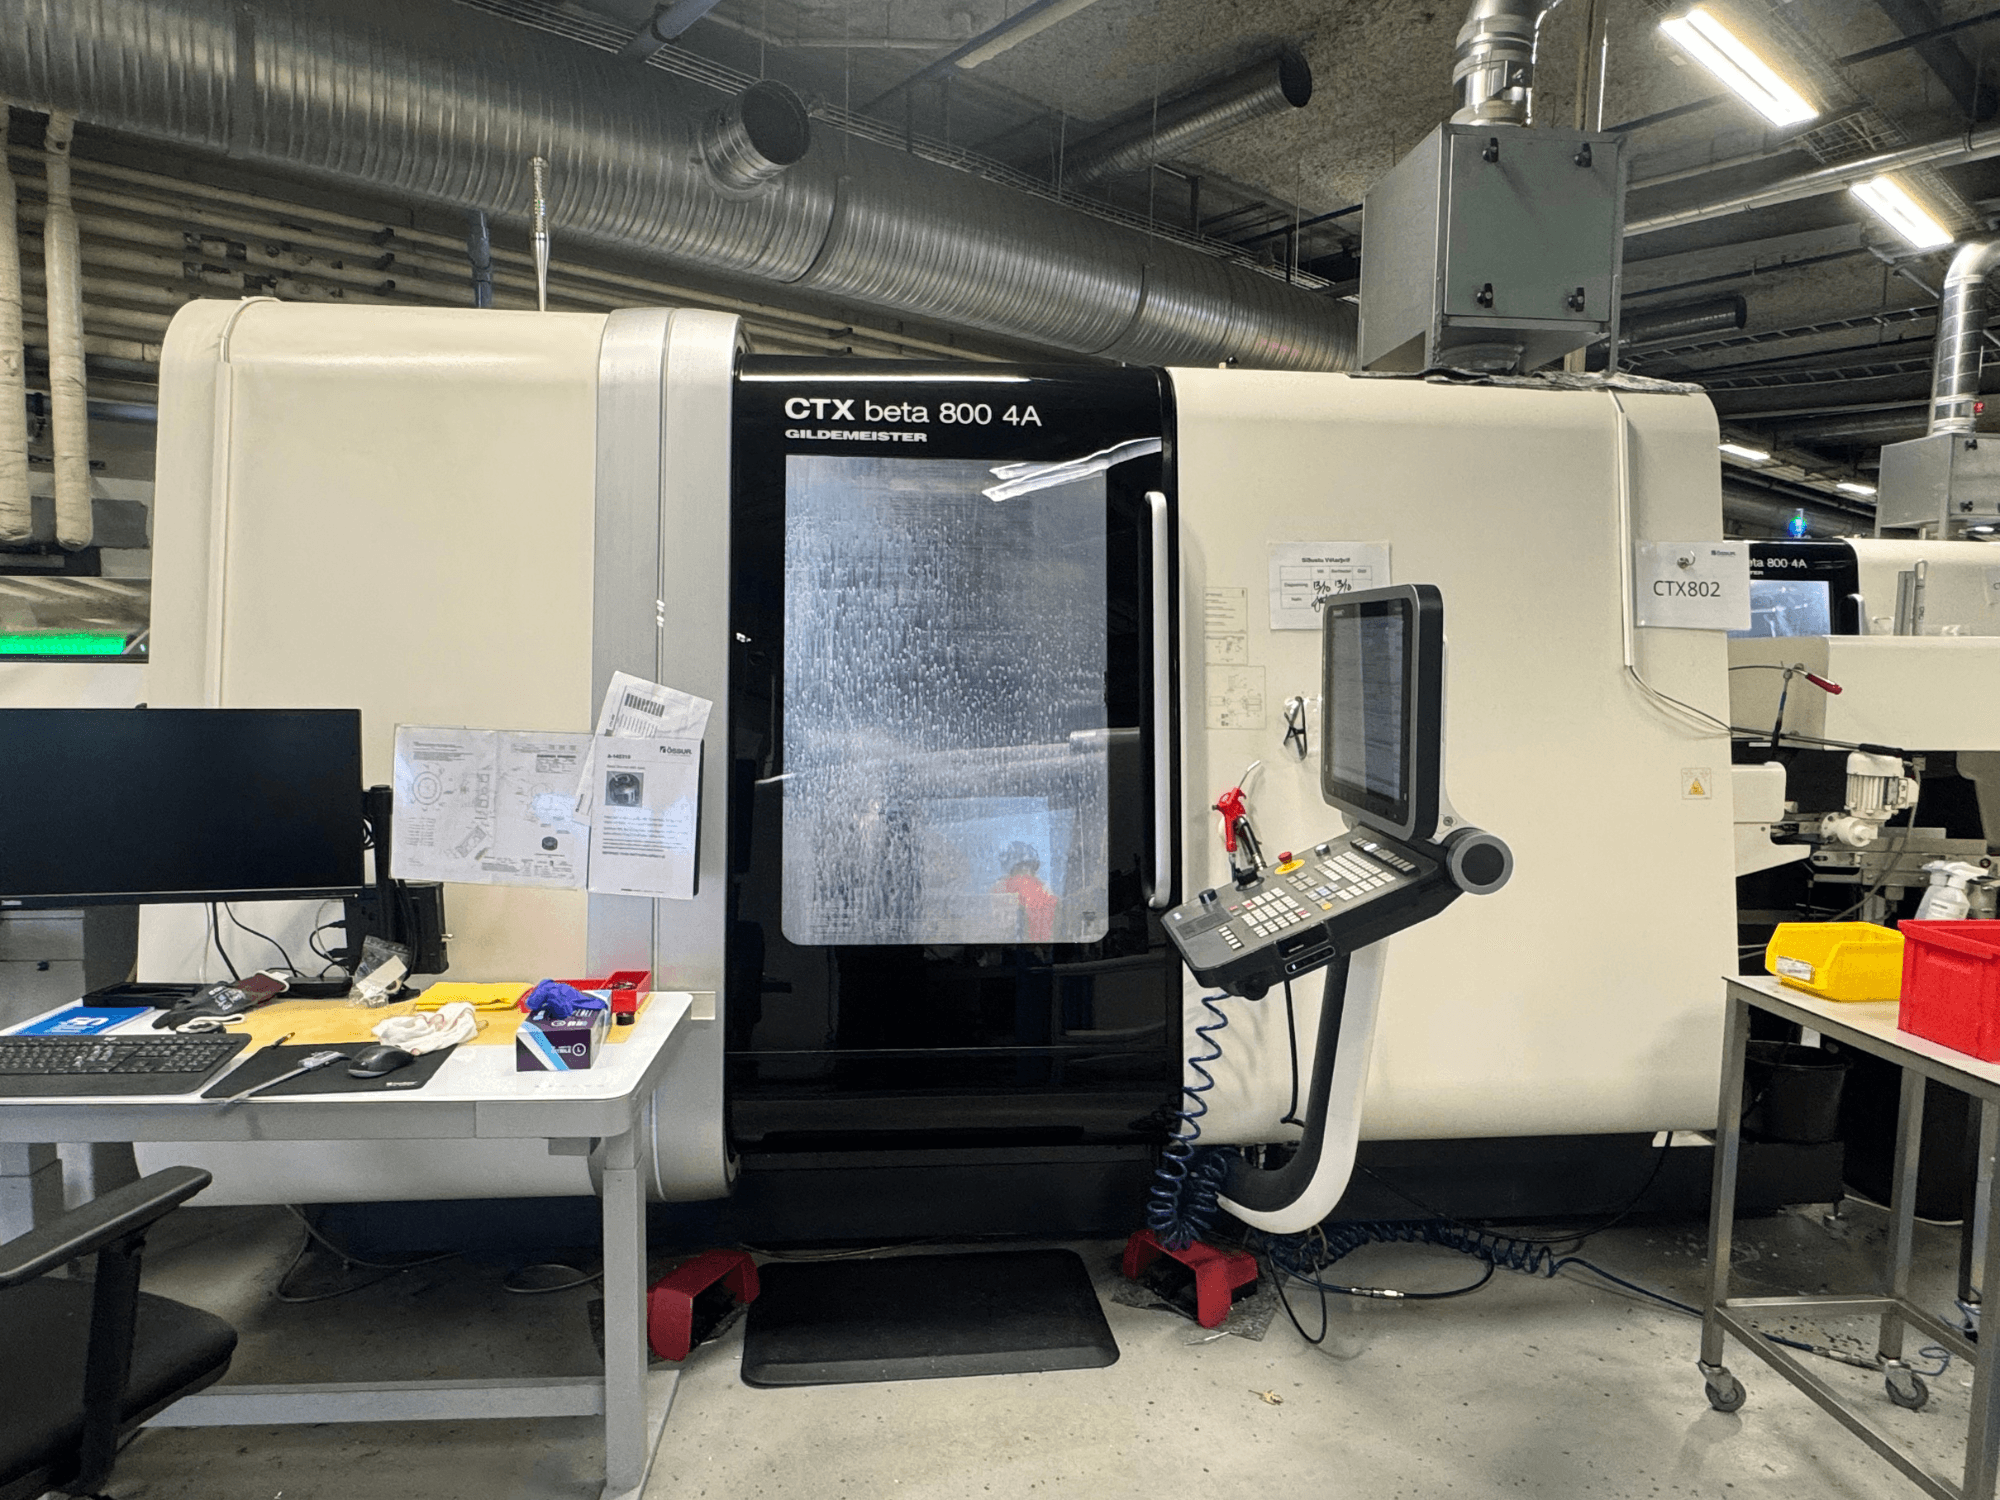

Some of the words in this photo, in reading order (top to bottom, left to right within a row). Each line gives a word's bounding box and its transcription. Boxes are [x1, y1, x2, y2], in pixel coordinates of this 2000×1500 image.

[784, 397, 856, 421] CTX
[865, 400, 930, 423] beta
[939, 402, 992, 425] 800
[1002, 405, 1042, 427] 4A
[785, 429, 927, 442] GILDEMEISTER
[1767, 558, 1788, 568] 800
[1791, 559, 1808, 568] 4A
[1653, 580, 1721, 597] CTX802
